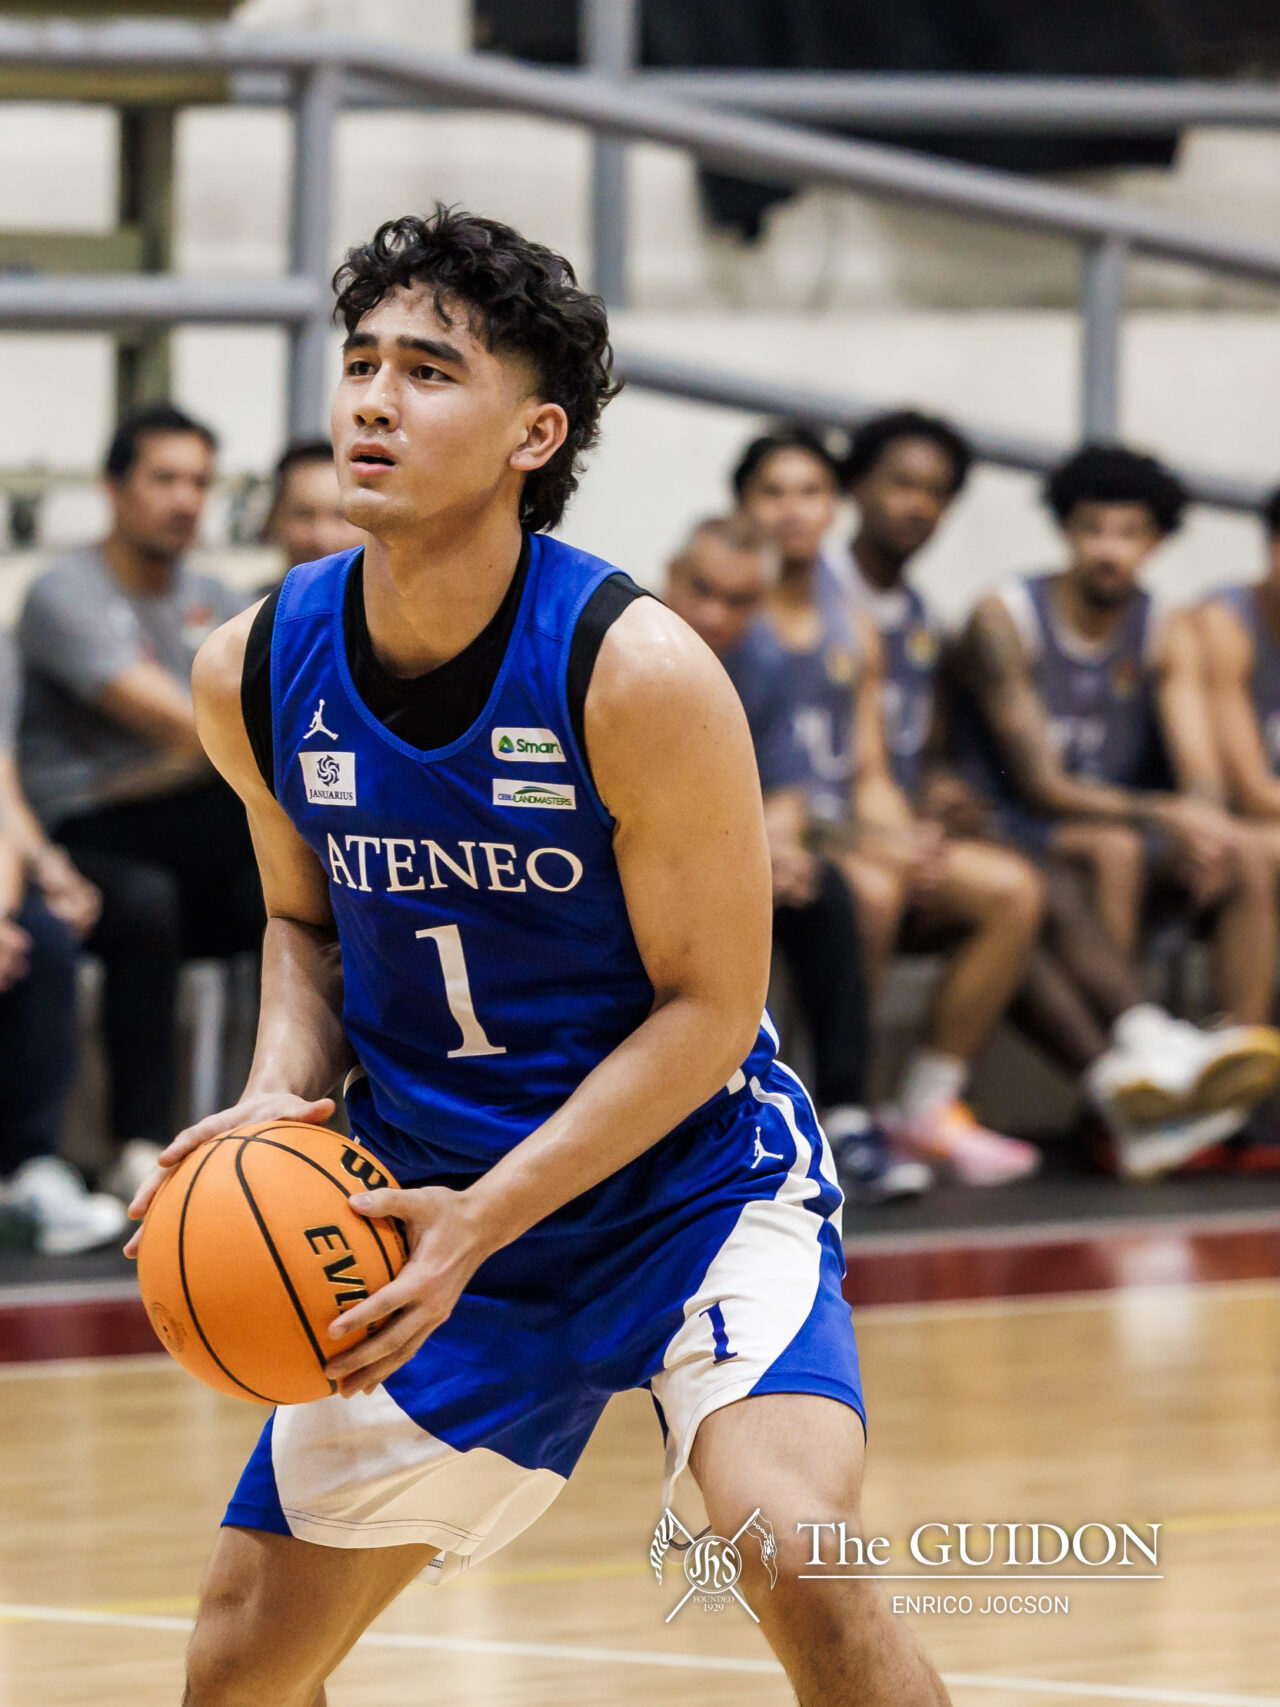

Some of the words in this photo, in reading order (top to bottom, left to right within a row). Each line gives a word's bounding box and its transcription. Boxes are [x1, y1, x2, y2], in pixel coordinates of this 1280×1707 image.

[309, 788, 354, 801] JANUARIUS
[513, 795, 572, 806] LANDMASTERS
[327, 833, 584, 893] ATENEO
[415, 924, 507, 1058] 1
[699, 1301, 738, 1365] 1
